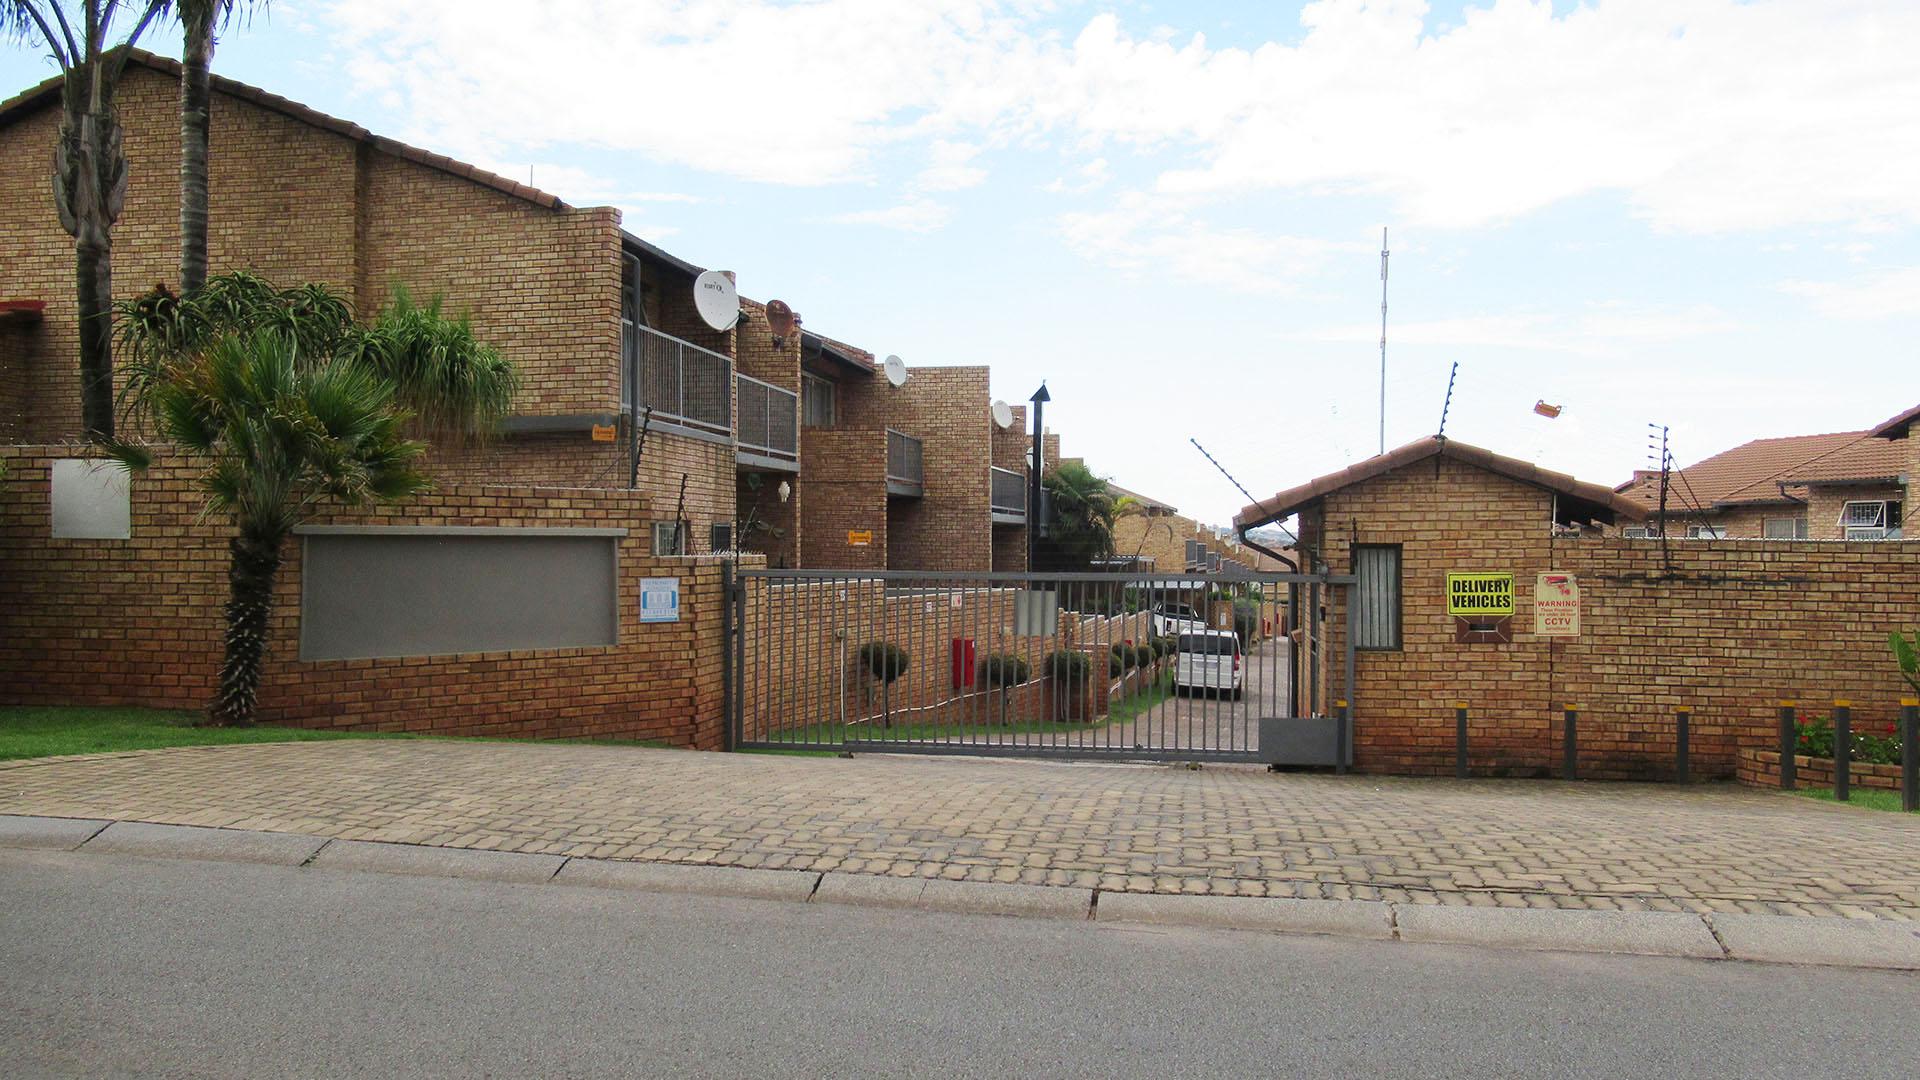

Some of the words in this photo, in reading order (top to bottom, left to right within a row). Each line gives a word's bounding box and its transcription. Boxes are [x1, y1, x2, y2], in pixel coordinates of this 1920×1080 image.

[1452, 580, 1510, 593] DELIVERY
[1452, 595, 1511, 608] VEHICLES
[1544, 617, 1571, 625] CCTV
